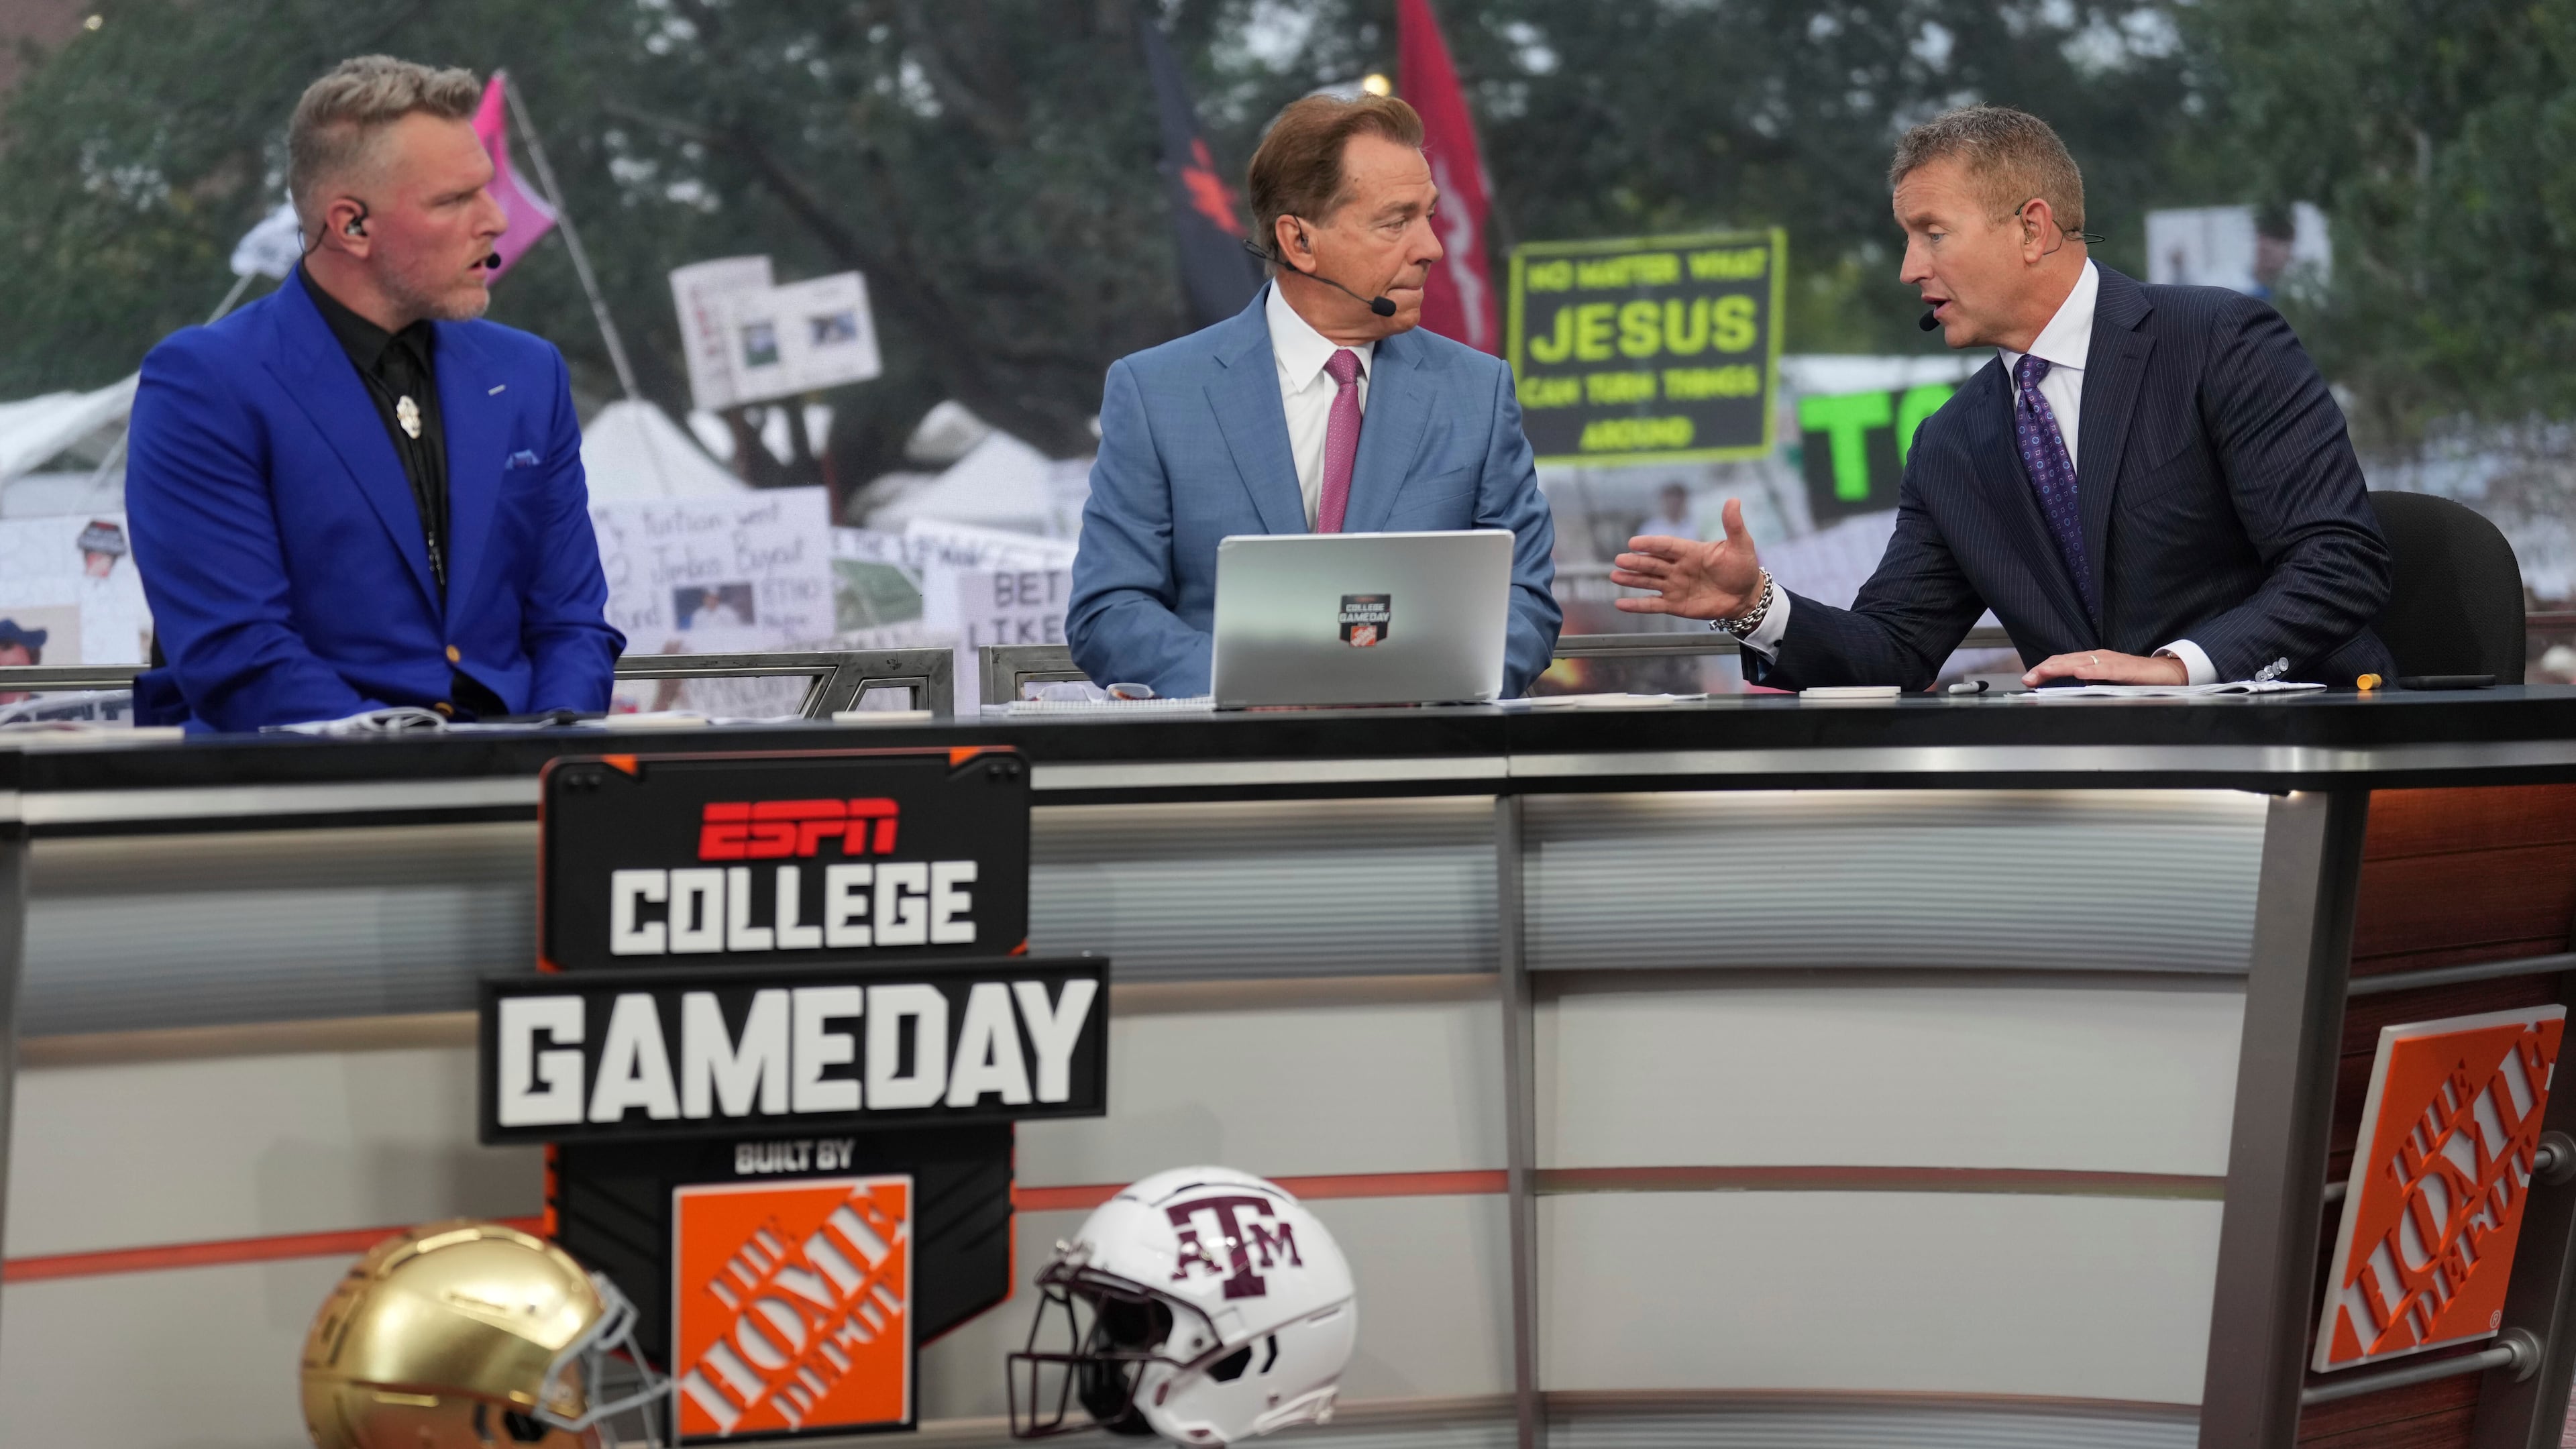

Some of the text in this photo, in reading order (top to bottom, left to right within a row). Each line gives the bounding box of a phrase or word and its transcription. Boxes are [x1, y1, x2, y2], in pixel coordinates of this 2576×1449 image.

[1527, 248, 1767, 291] NO MATTER WHAT
[1529, 294, 1757, 363] JESUS
[1520, 364, 1759, 409] CAN TURN THINGS
[1580, 416, 1694, 450] AROUND
[994, 570, 1062, 606] BET
[1339, 612, 1390, 623] GAMEDAY
[1345, 603, 1385, 612] COLLEGE
[968, 614, 1062, 651] LIKE
[698, 798, 900, 861] ESPN
[610, 861, 978, 955] COLLEGE
[497, 979, 1099, 1127] GAMEDAY
[735, 1138, 855, 1175] BUILT BY
[2386, 1057, 2474, 1197] THE
[2342, 1021, 2554, 1355] HOME
[702, 1214, 797, 1311] THE
[2405, 1135, 2533, 1346] DEPOT
[680, 1182, 908, 1438] HOME
[771, 1271, 904, 1432] DEPOT
